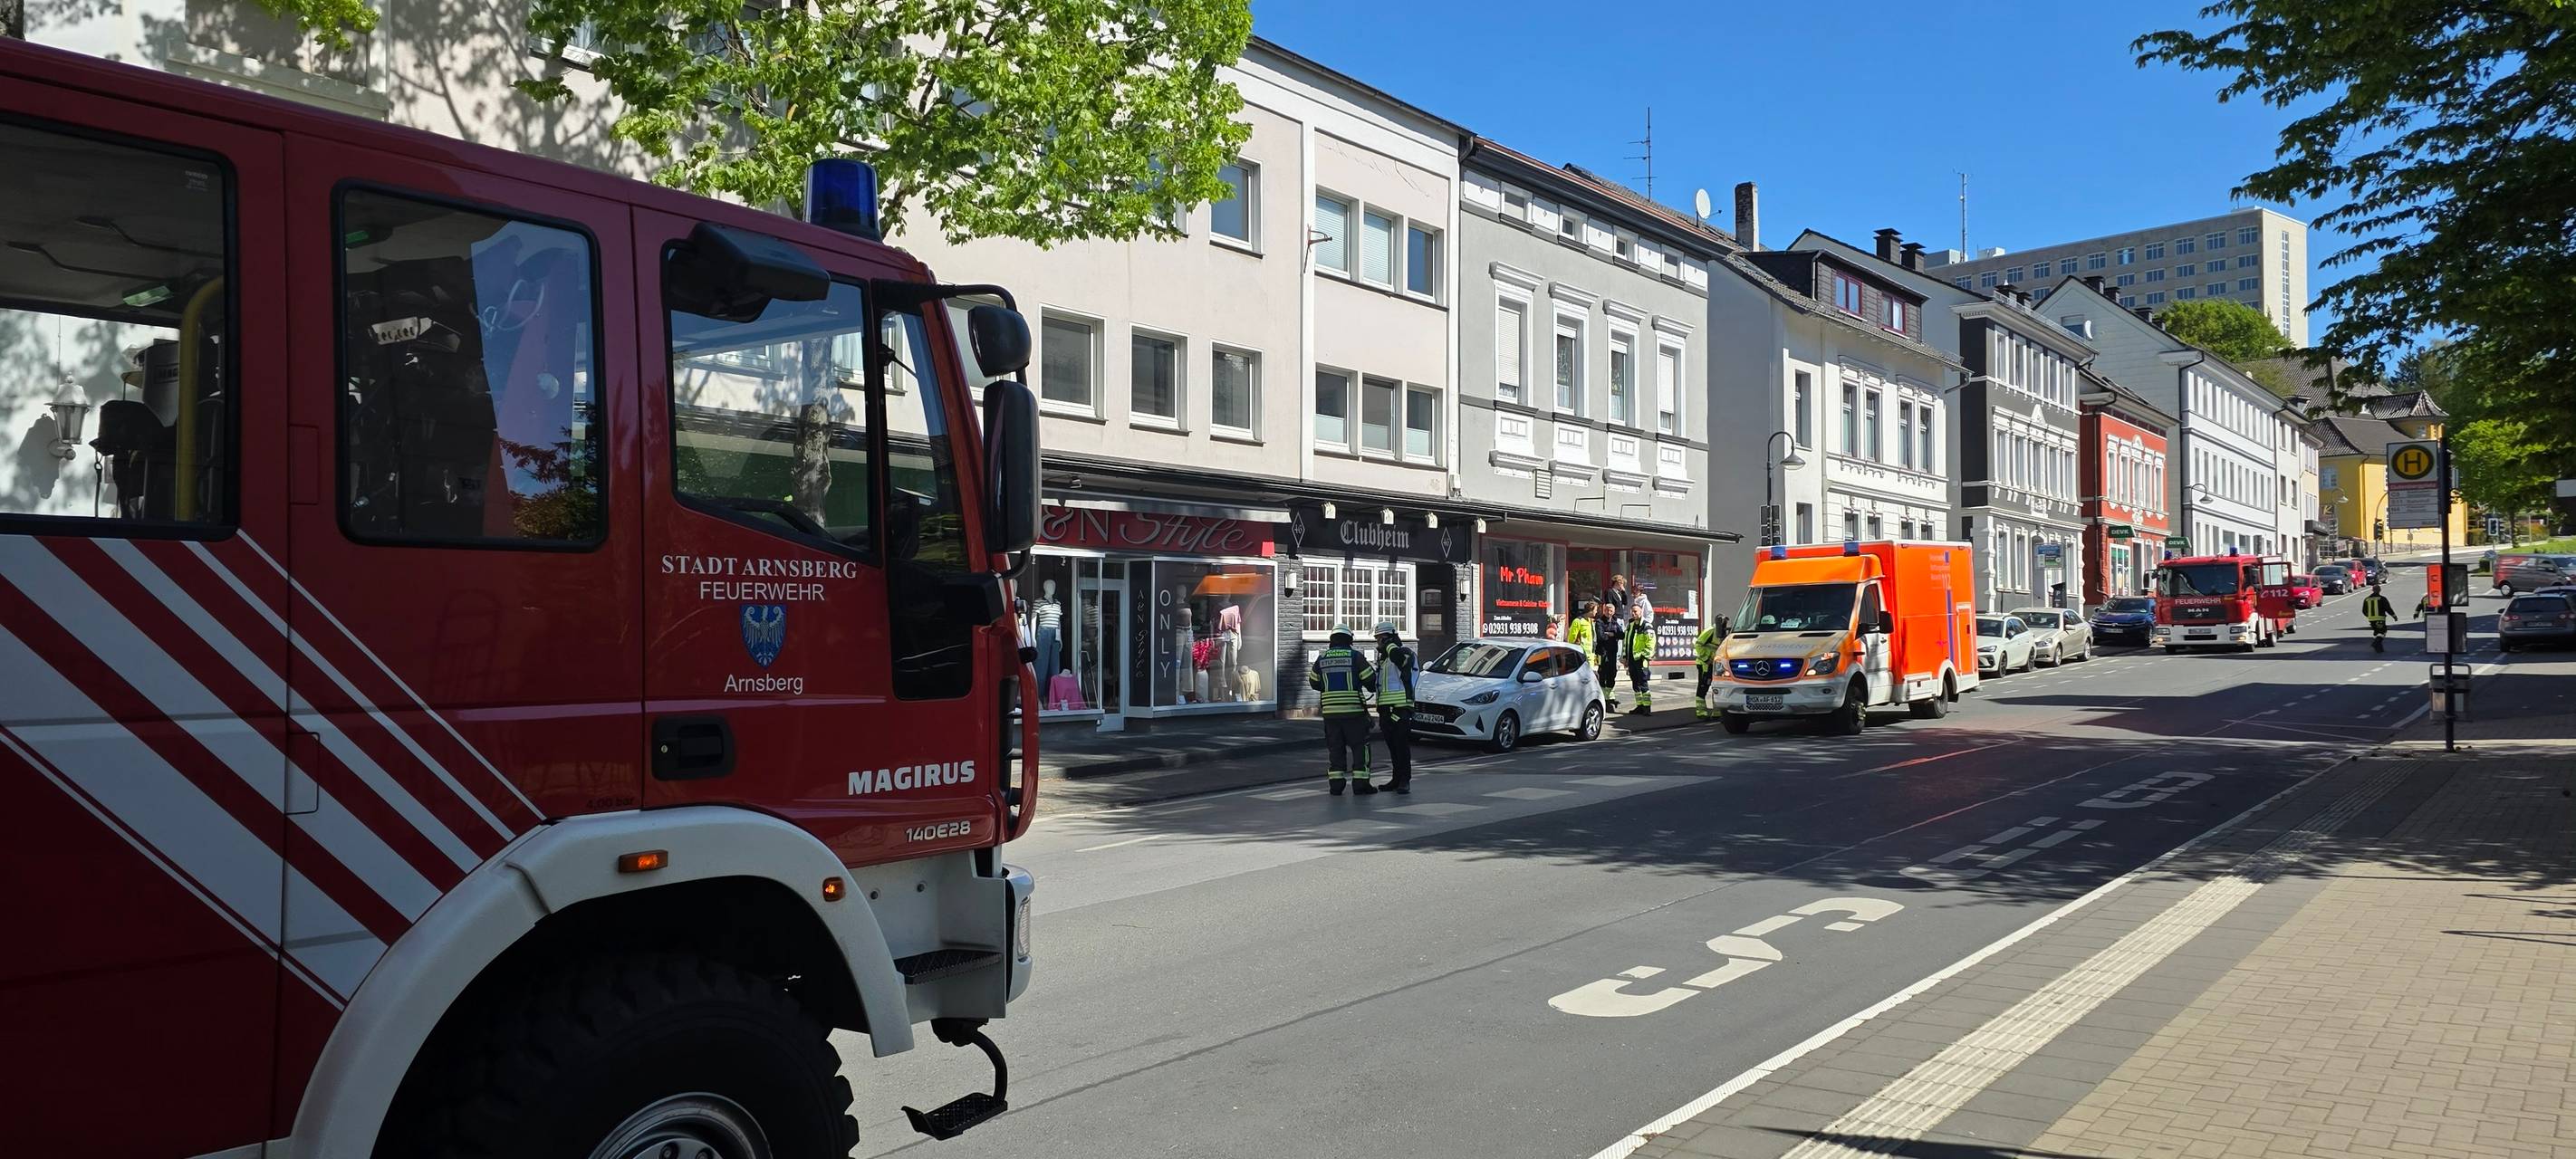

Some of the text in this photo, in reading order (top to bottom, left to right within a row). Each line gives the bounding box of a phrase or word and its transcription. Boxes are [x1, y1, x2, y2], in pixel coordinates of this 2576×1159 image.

[2404, 452, 2421, 473] H
[1120, 513, 1253, 552] Style
[1293, 523, 1302, 534] 46
[1340, 519, 1410, 551] Clubheim
[661, 554, 858, 579] STADT ARNSBERG
[1500, 566, 1543, 586] Mr. Pham
[700, 581, 825, 601] FEUERWEHR
[2270, 589, 2289, 598] 112
[1159, 589, 1171, 678] ONLY
[1488, 622, 1539, 634] 02931 938 9308
[725, 674, 803, 695] Arnsberg
[848, 760, 976, 795] MAGIRUS
[906, 819, 971, 843] 140E28
